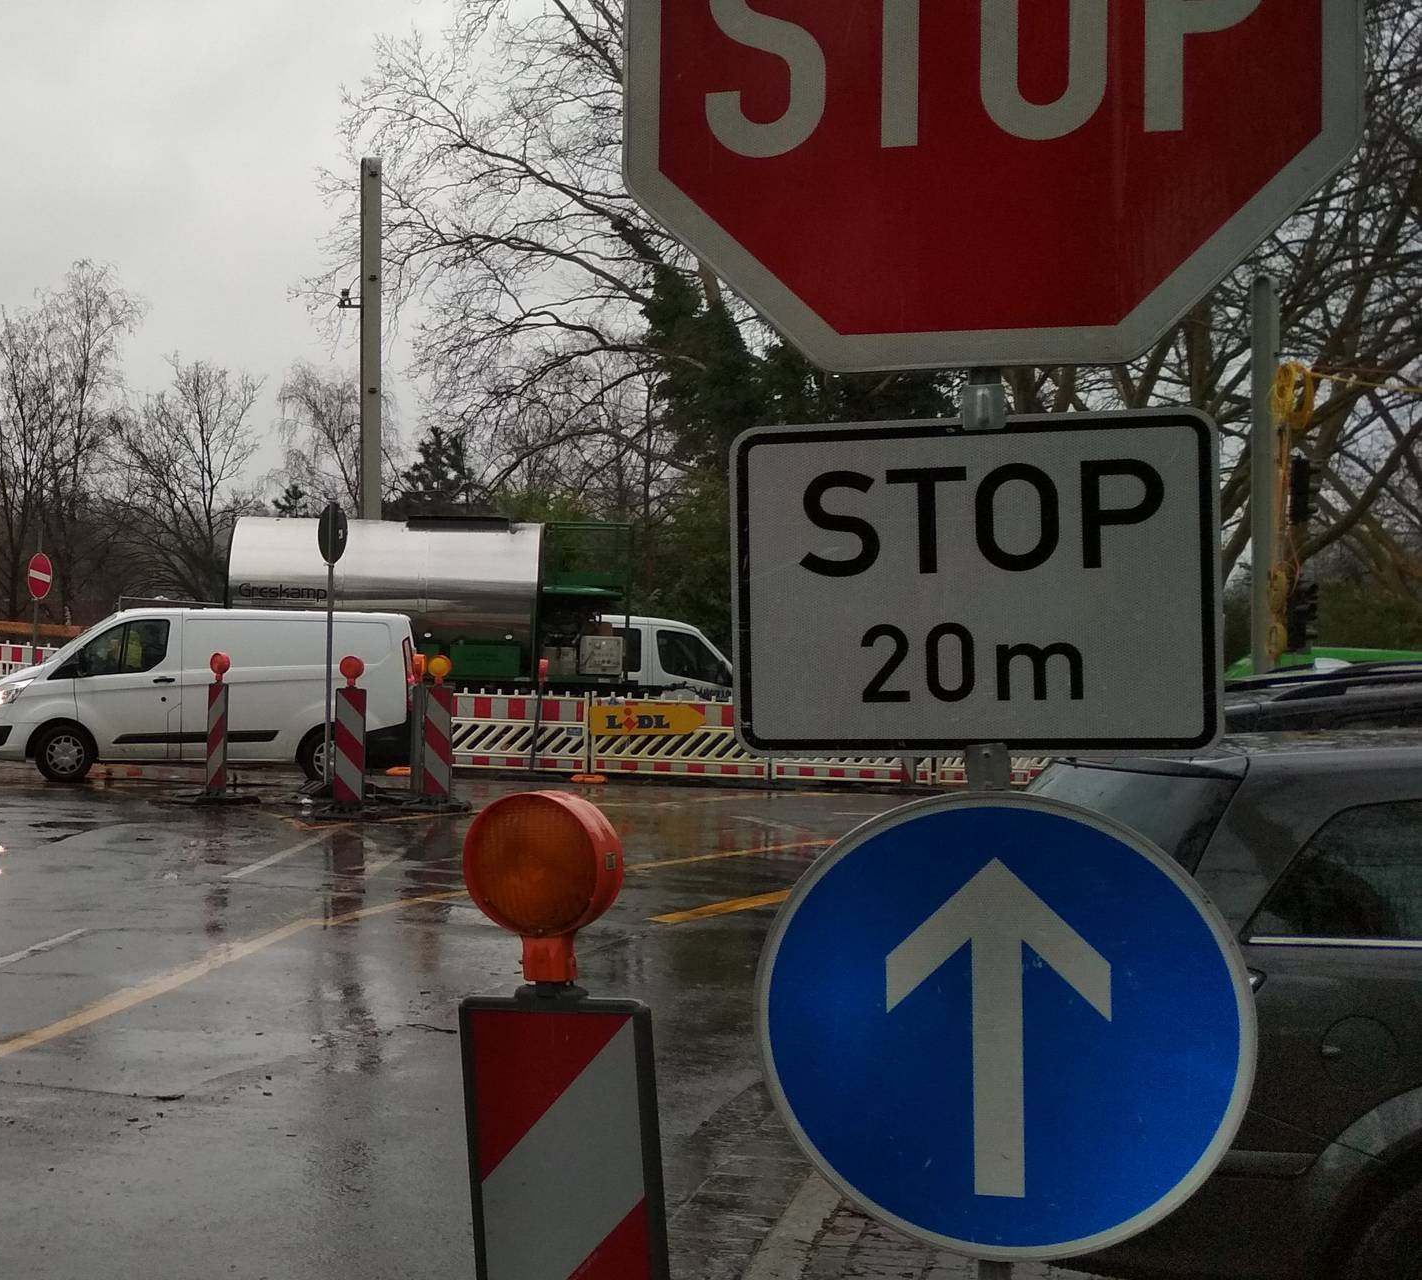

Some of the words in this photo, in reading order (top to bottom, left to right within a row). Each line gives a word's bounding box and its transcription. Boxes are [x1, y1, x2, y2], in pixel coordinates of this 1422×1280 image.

[705, 0, 1269, 158] STOP
[799, 458, 1165, 578] STOP
[239, 583, 327, 602] Greskamp
